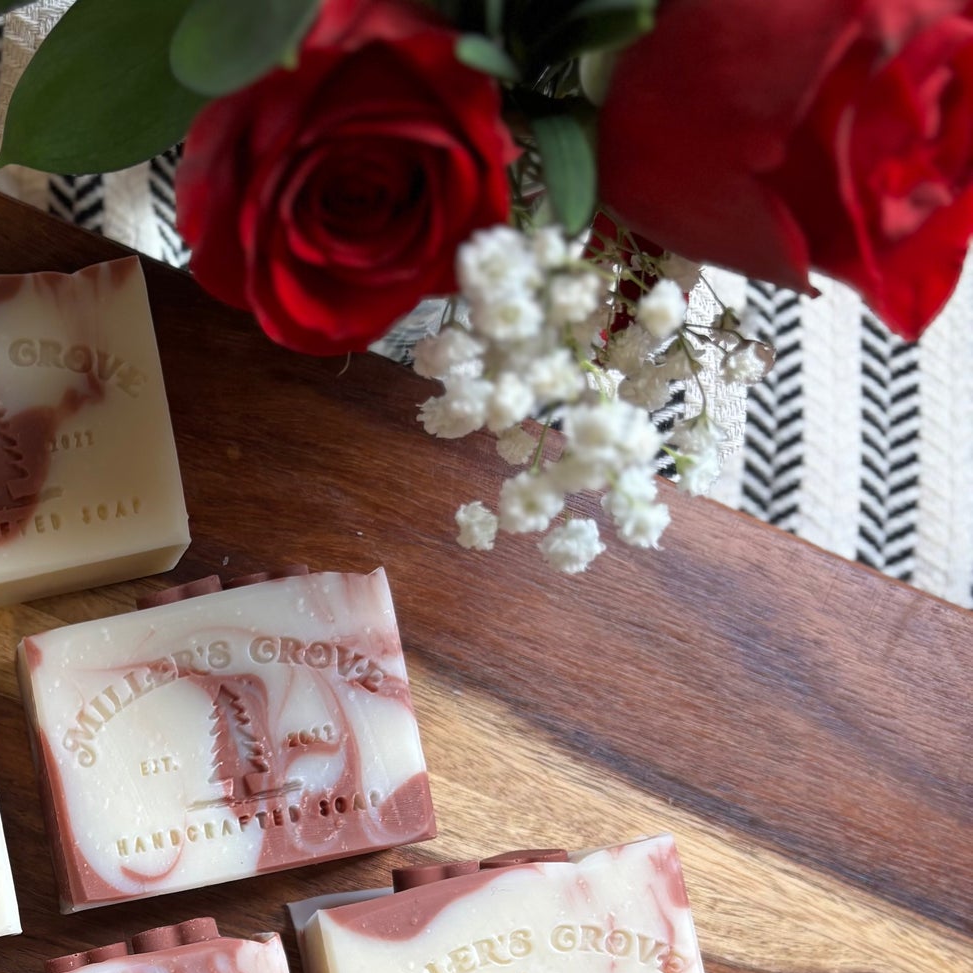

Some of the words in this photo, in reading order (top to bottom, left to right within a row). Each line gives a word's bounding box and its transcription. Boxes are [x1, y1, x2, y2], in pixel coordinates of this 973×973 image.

[8, 338, 147, 398] GROVE
[81, 498, 141, 524] SOAP
[63, 640, 231, 767] MILLER'S
[249, 636, 386, 693] GROVE
[117, 806, 301, 855] HANDCRAFTED
[319, 790, 381, 815] SOAP
